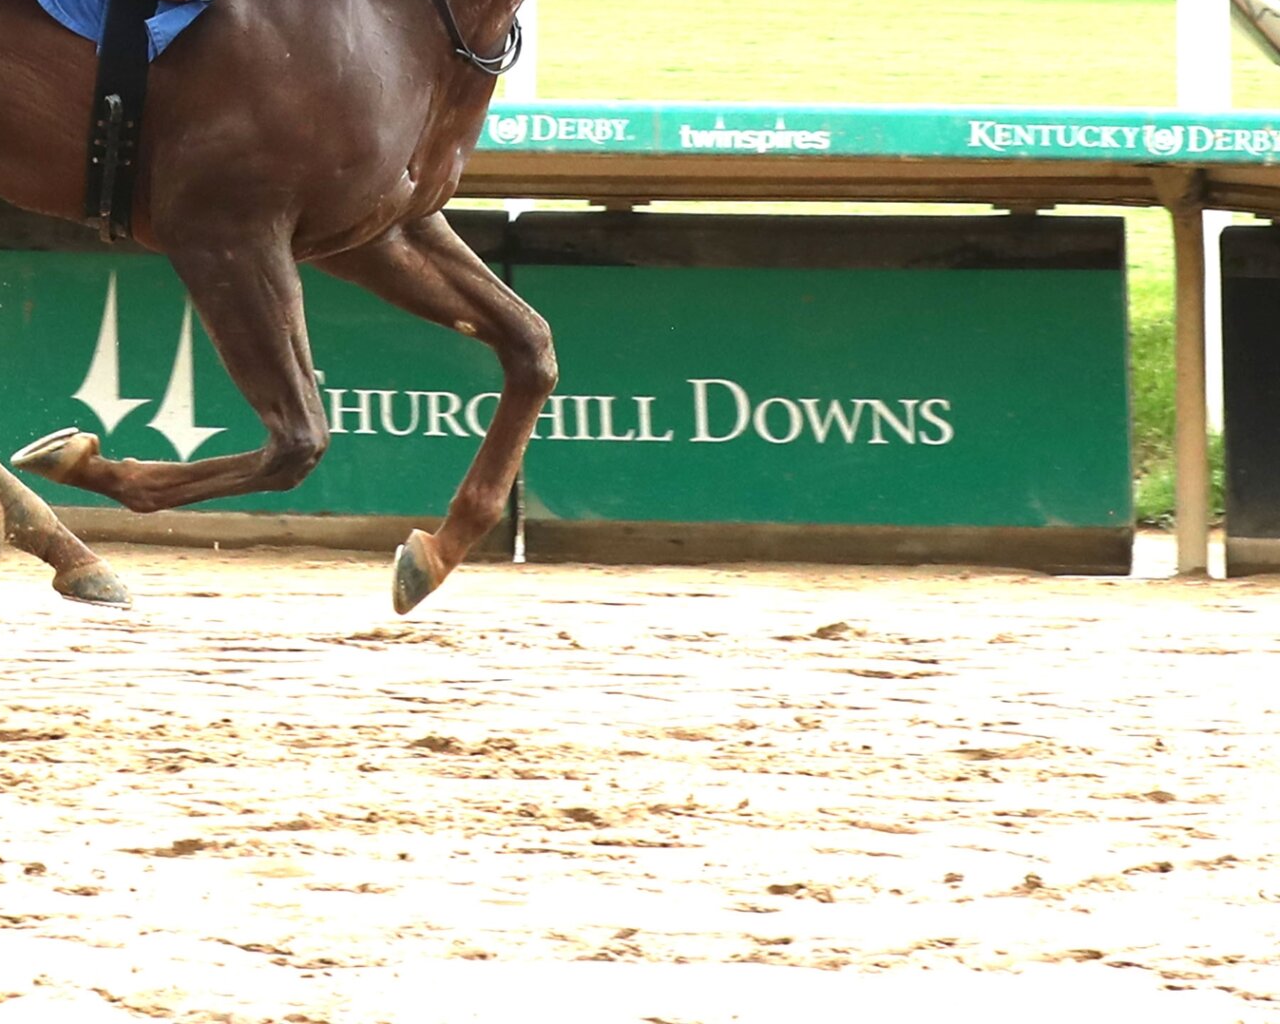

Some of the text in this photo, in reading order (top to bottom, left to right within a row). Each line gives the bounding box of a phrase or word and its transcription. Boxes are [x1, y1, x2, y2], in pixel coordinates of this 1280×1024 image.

[533, 114, 630, 145] DERBY
[679, 115, 831, 153] twinspires
[968, 120, 1140, 152] KENTUCKY
[314, 370, 954, 445] HURCHILL DOWNS
